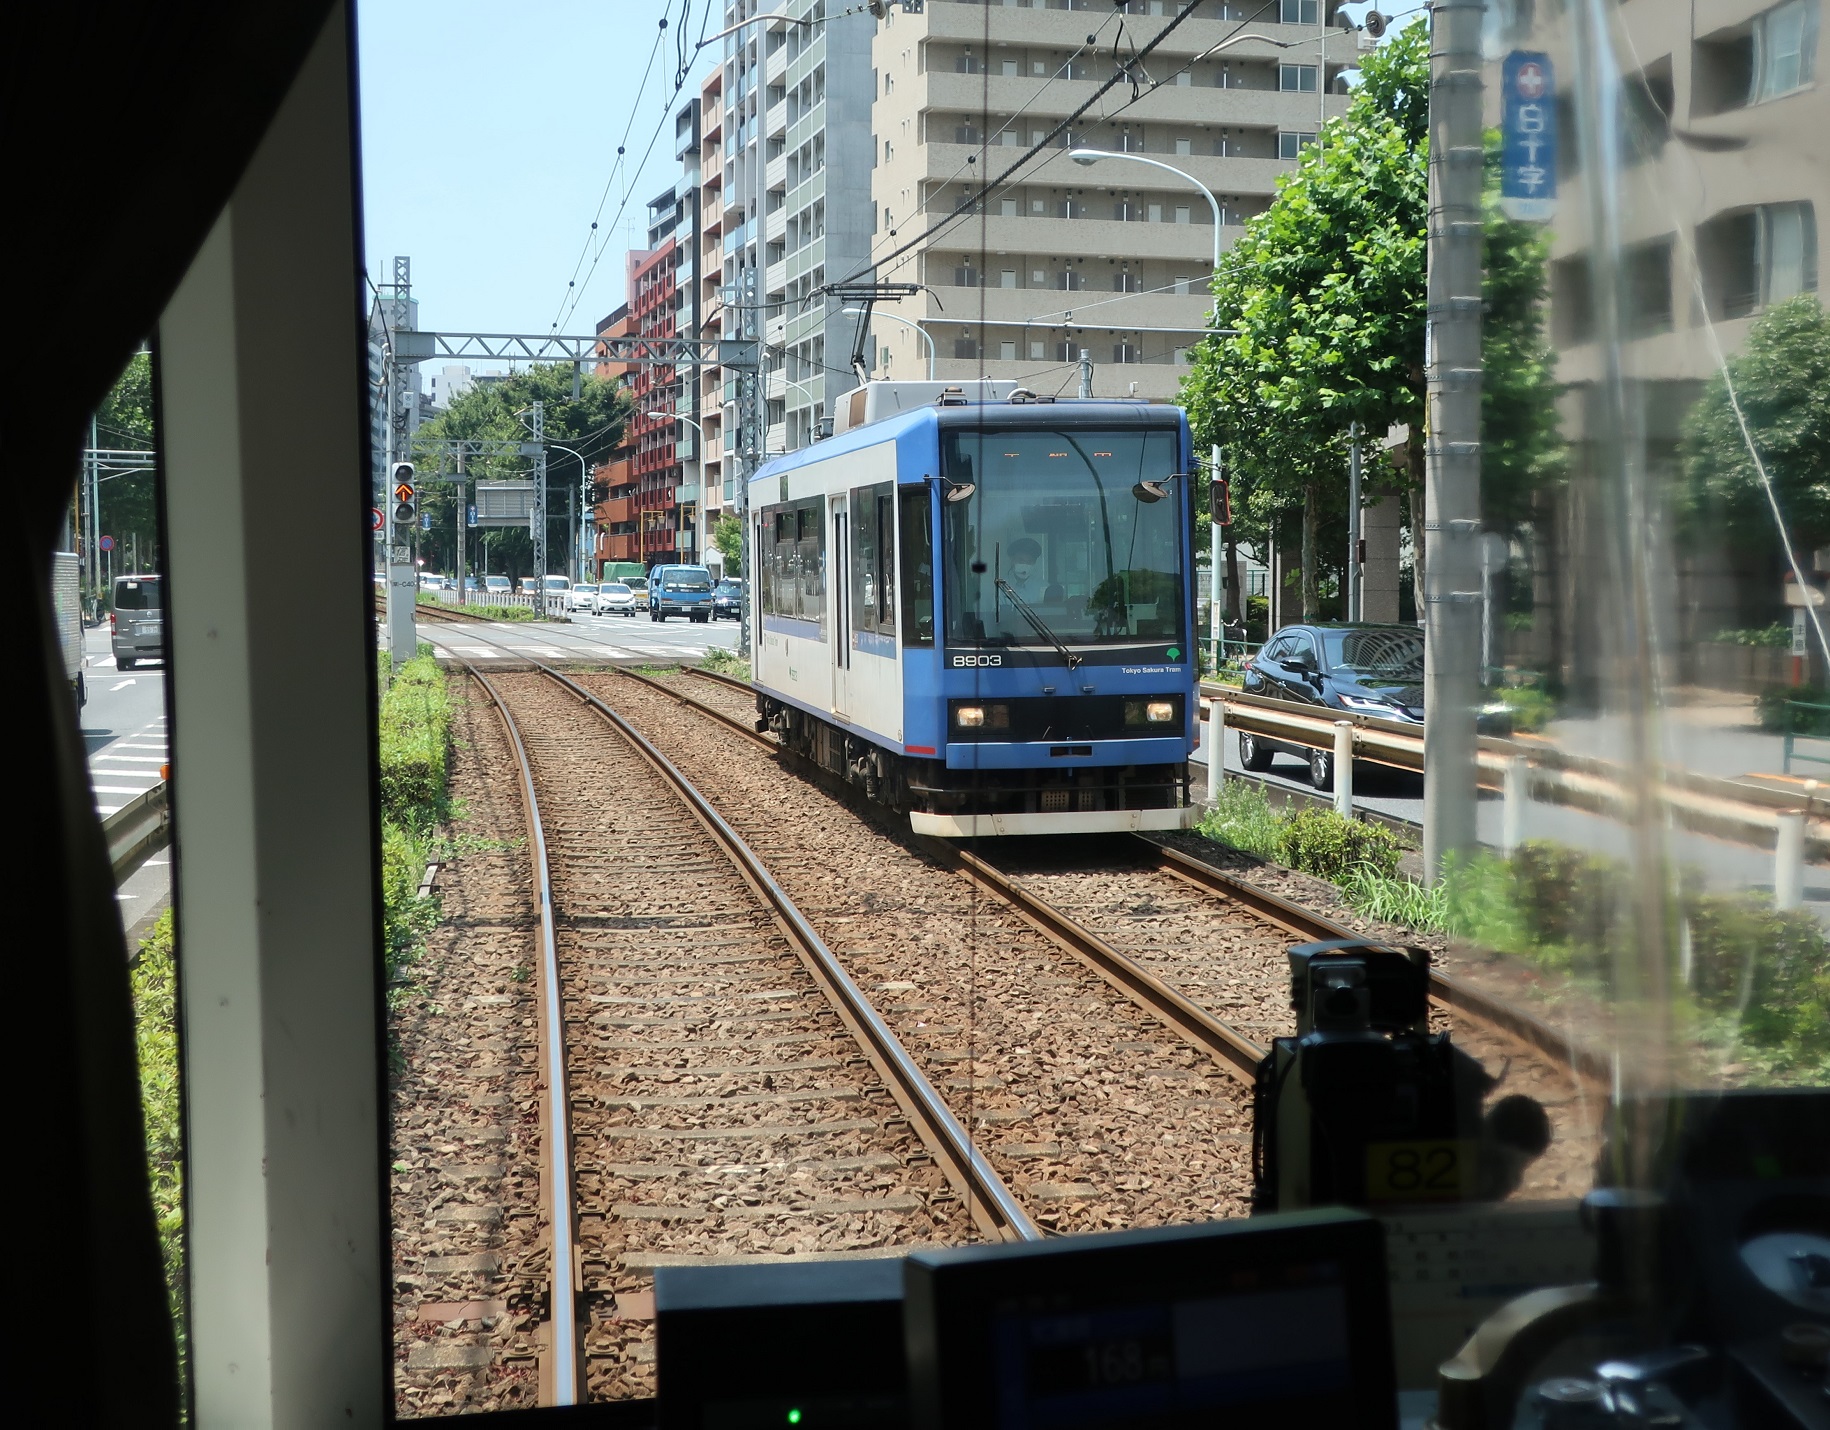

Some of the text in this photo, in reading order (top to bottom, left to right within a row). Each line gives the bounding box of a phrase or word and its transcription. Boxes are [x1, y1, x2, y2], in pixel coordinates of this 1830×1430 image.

[953, 655, 1002, 667] 8903
[1121, 667, 1142, 675] Tokyo
[1387, 1147, 1458, 1191] 82
